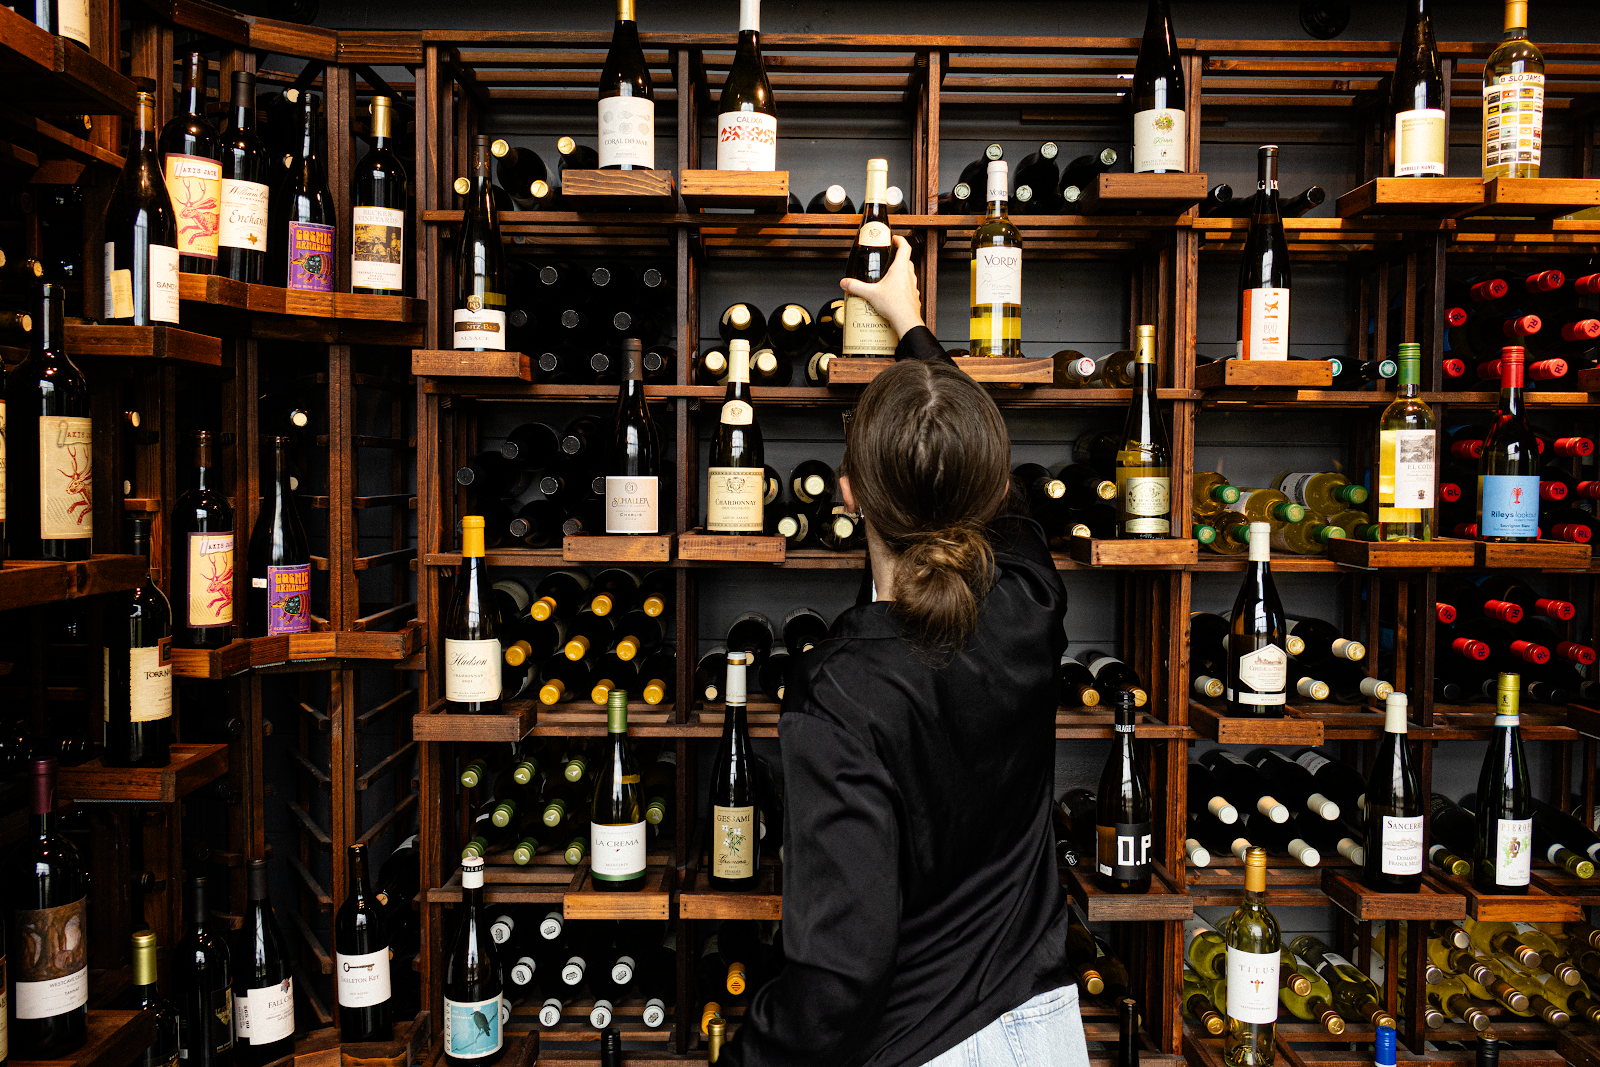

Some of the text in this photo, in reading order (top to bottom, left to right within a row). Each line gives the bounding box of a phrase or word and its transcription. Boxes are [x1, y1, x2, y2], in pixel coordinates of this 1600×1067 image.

[736, 116, 763, 125] CALIXA
[604, 138, 624, 146] CORAL
[182, 167, 201, 175] AXIS
[363, 209, 393, 219] BECKER
[357, 215, 398, 225] VINEYARDS
[984, 254, 1018, 267] VORDY
[1550, 273, 1561, 285] RL
[1493, 283, 1506, 294] RL
[1452, 312, 1465, 322] RL
[1526, 318, 1539, 329] RL
[1587, 322, 1599, 334] RL
[1451, 362, 1462, 373] RL
[1554, 362, 1564, 374] RL
[67, 431, 85, 439] AXIS
[1581, 441, 1590, 454] RL
[1447, 488, 1459, 497] RL
[611, 497, 651, 508] SCHALLER
[715, 498, 757, 506] CHARDONNAY
[1491, 510, 1514, 520] Rileys
[1577, 530, 1589, 538] RL
[1444, 608, 1454, 620] RL
[1510, 608, 1520, 620] RL
[1563, 606, 1571, 618] RL
[1477, 645, 1485, 657] RL
[1536, 651, 1549, 661] RL
[447, 652, 488, 669] Hudson
[1582, 652, 1594, 661] RL
[595, 839, 639, 848] LA CREMA
[1239, 964, 1275, 974] TITUS
[340, 975, 367, 984] SKELETON
[268, 999, 284, 1009] FALL
